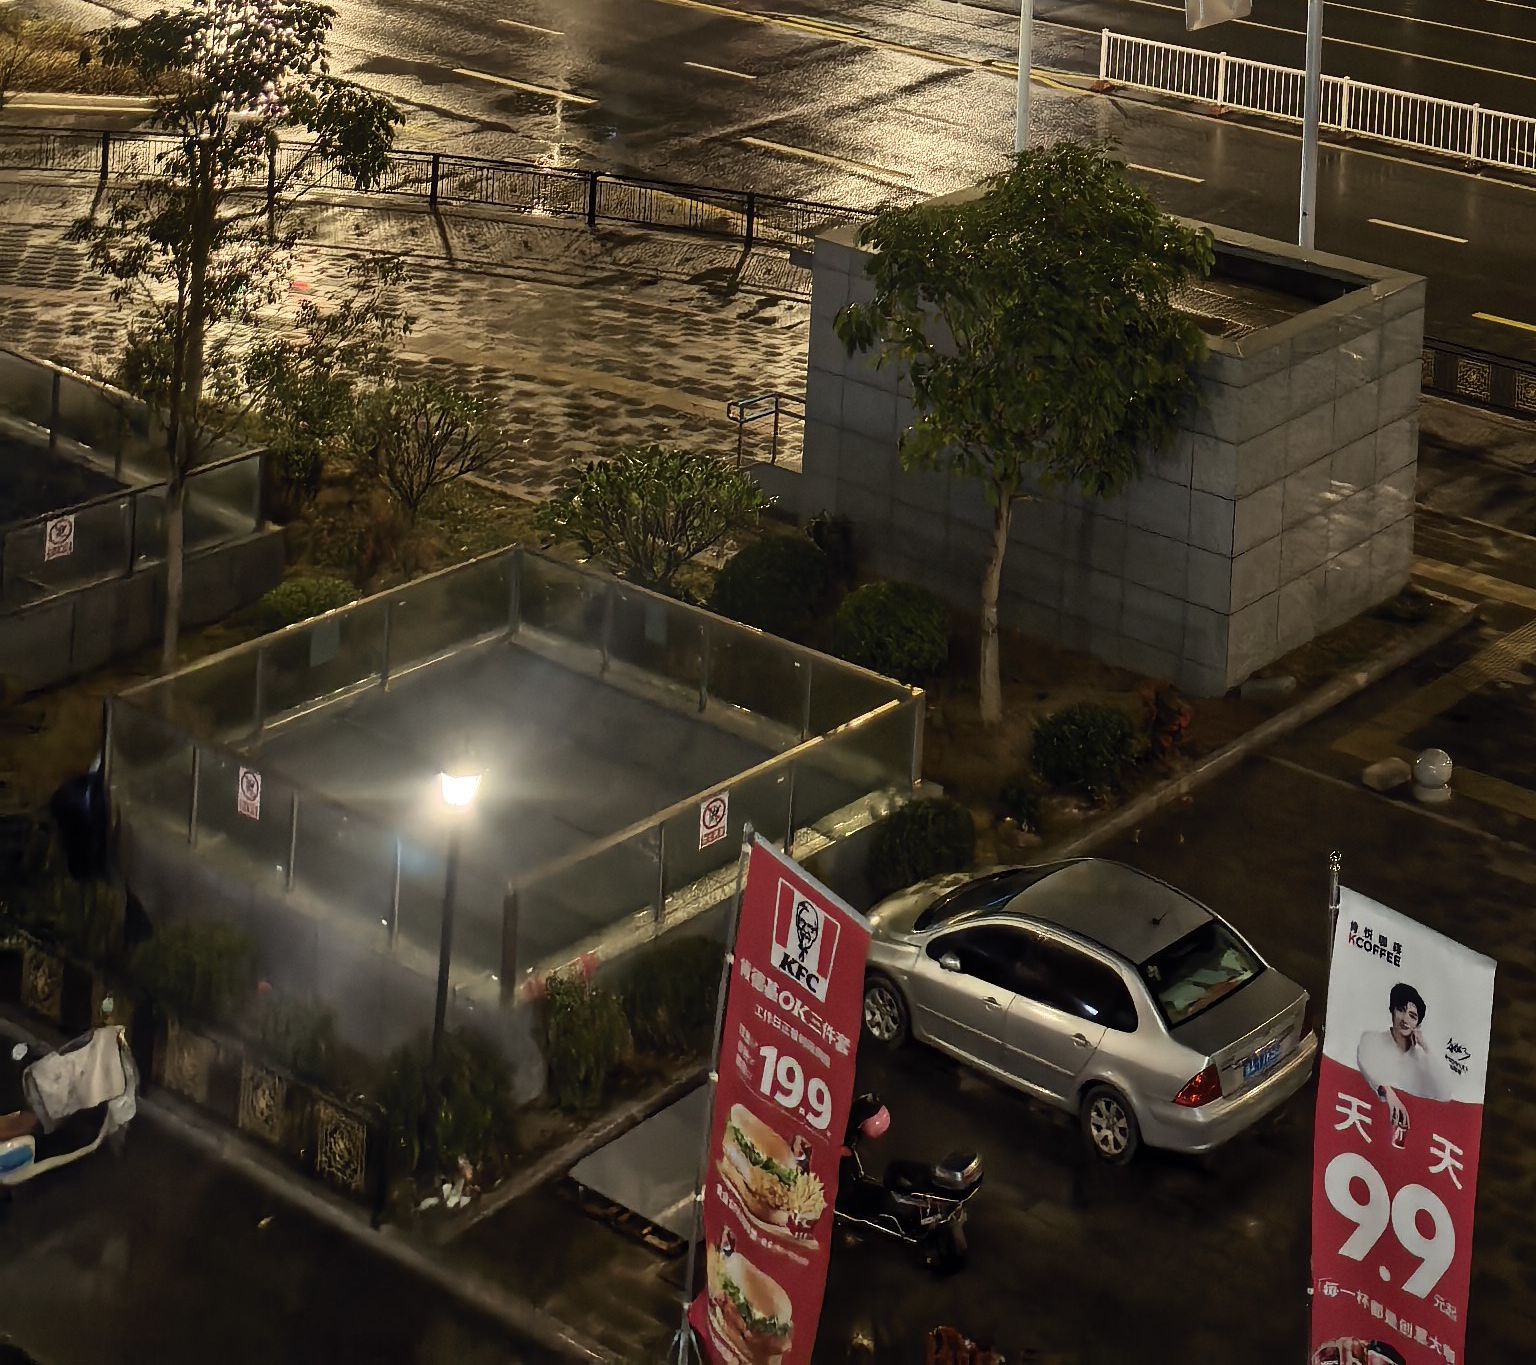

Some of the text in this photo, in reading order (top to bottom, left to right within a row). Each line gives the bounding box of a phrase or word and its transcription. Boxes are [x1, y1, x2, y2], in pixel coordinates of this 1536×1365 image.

[779, 951, 820, 994] KFC
[1348, 932, 1402, 967] KCOFFEE
[758, 1045, 833, 1130] 19.9
[1324, 1152, 1456, 1300] 9.9
